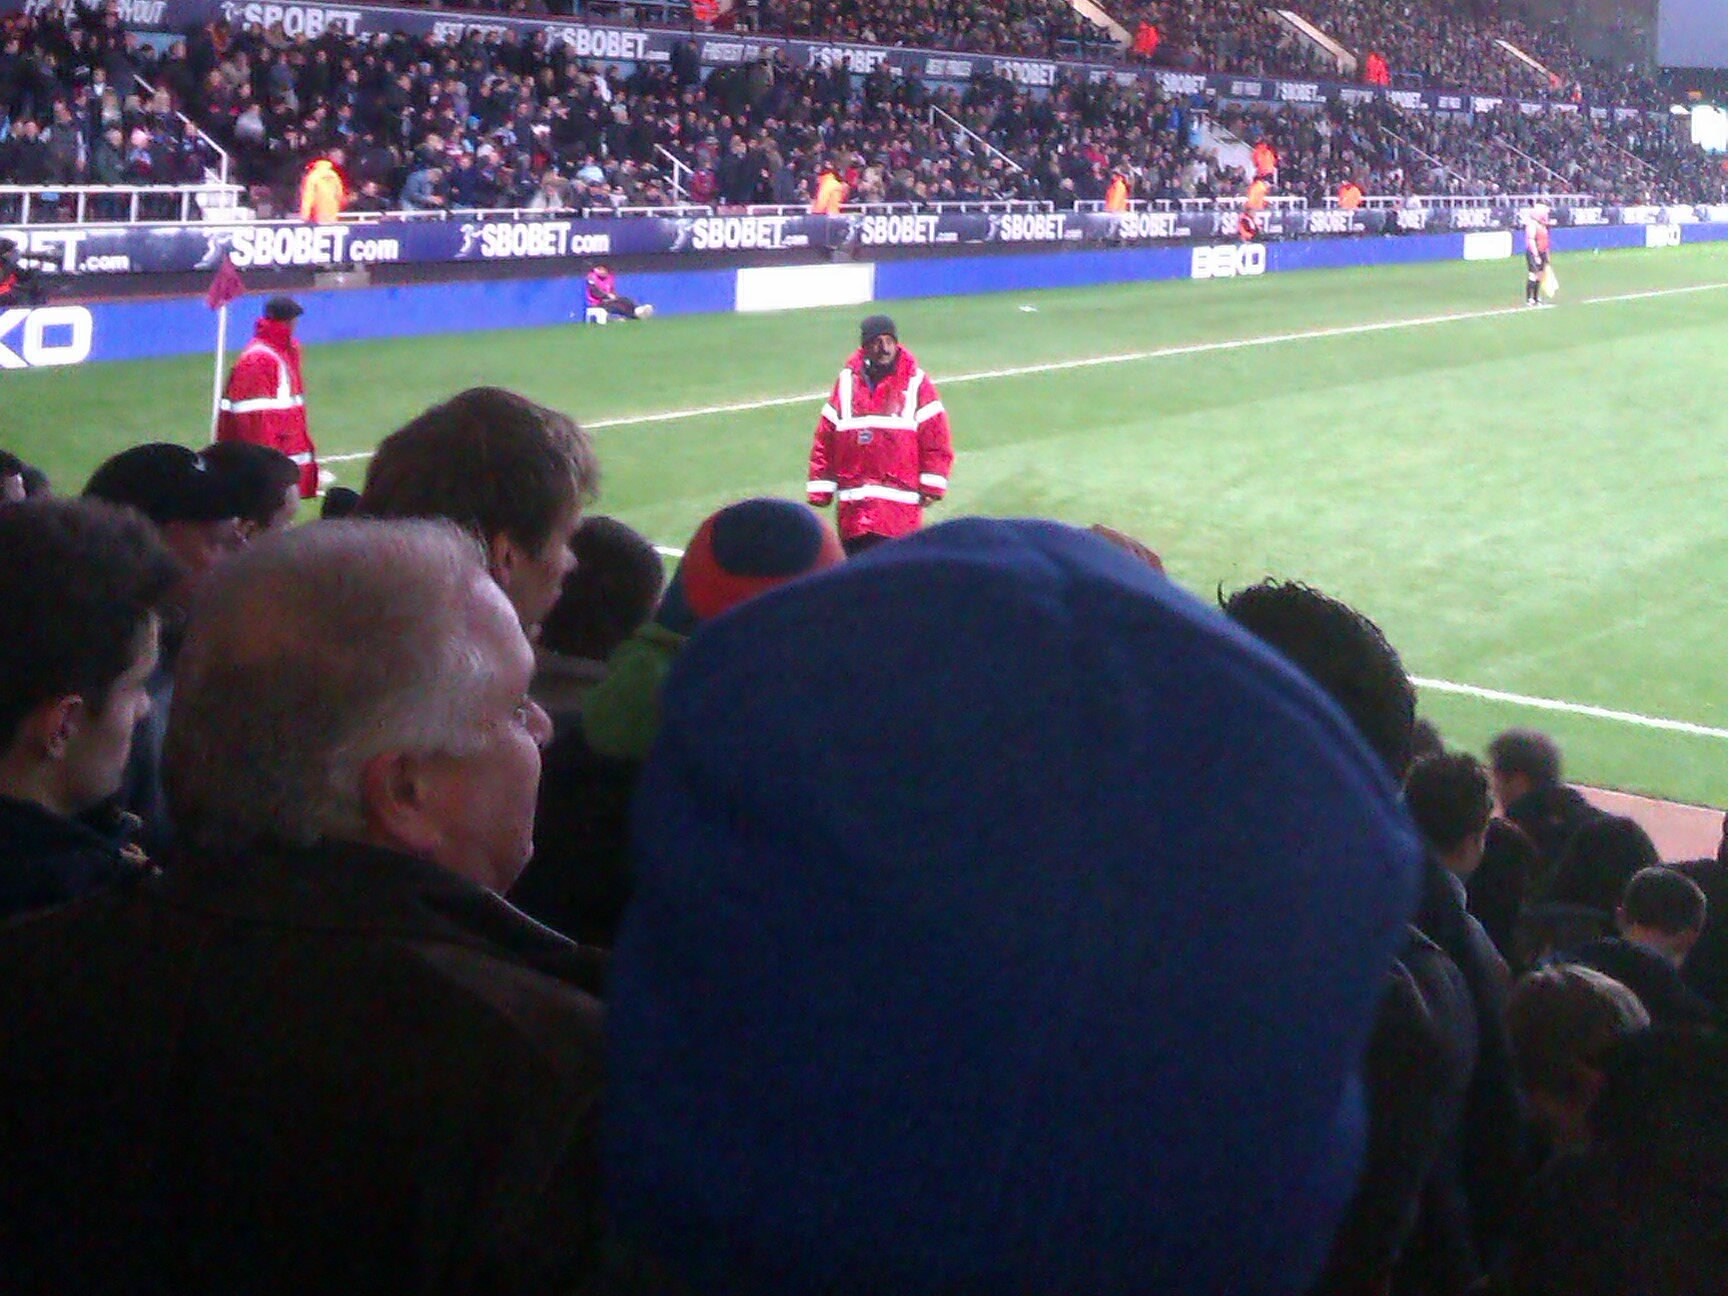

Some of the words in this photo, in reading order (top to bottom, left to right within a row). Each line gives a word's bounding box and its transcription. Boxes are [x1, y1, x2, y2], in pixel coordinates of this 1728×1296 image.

[480, 221, 571, 257] SBOBET
[691, 217, 788, 250] SBOBET
[860, 214, 939, 245] SBOBET
[1000, 213, 1066, 241] SBOBET
[229, 225, 349, 267] SBOBET
